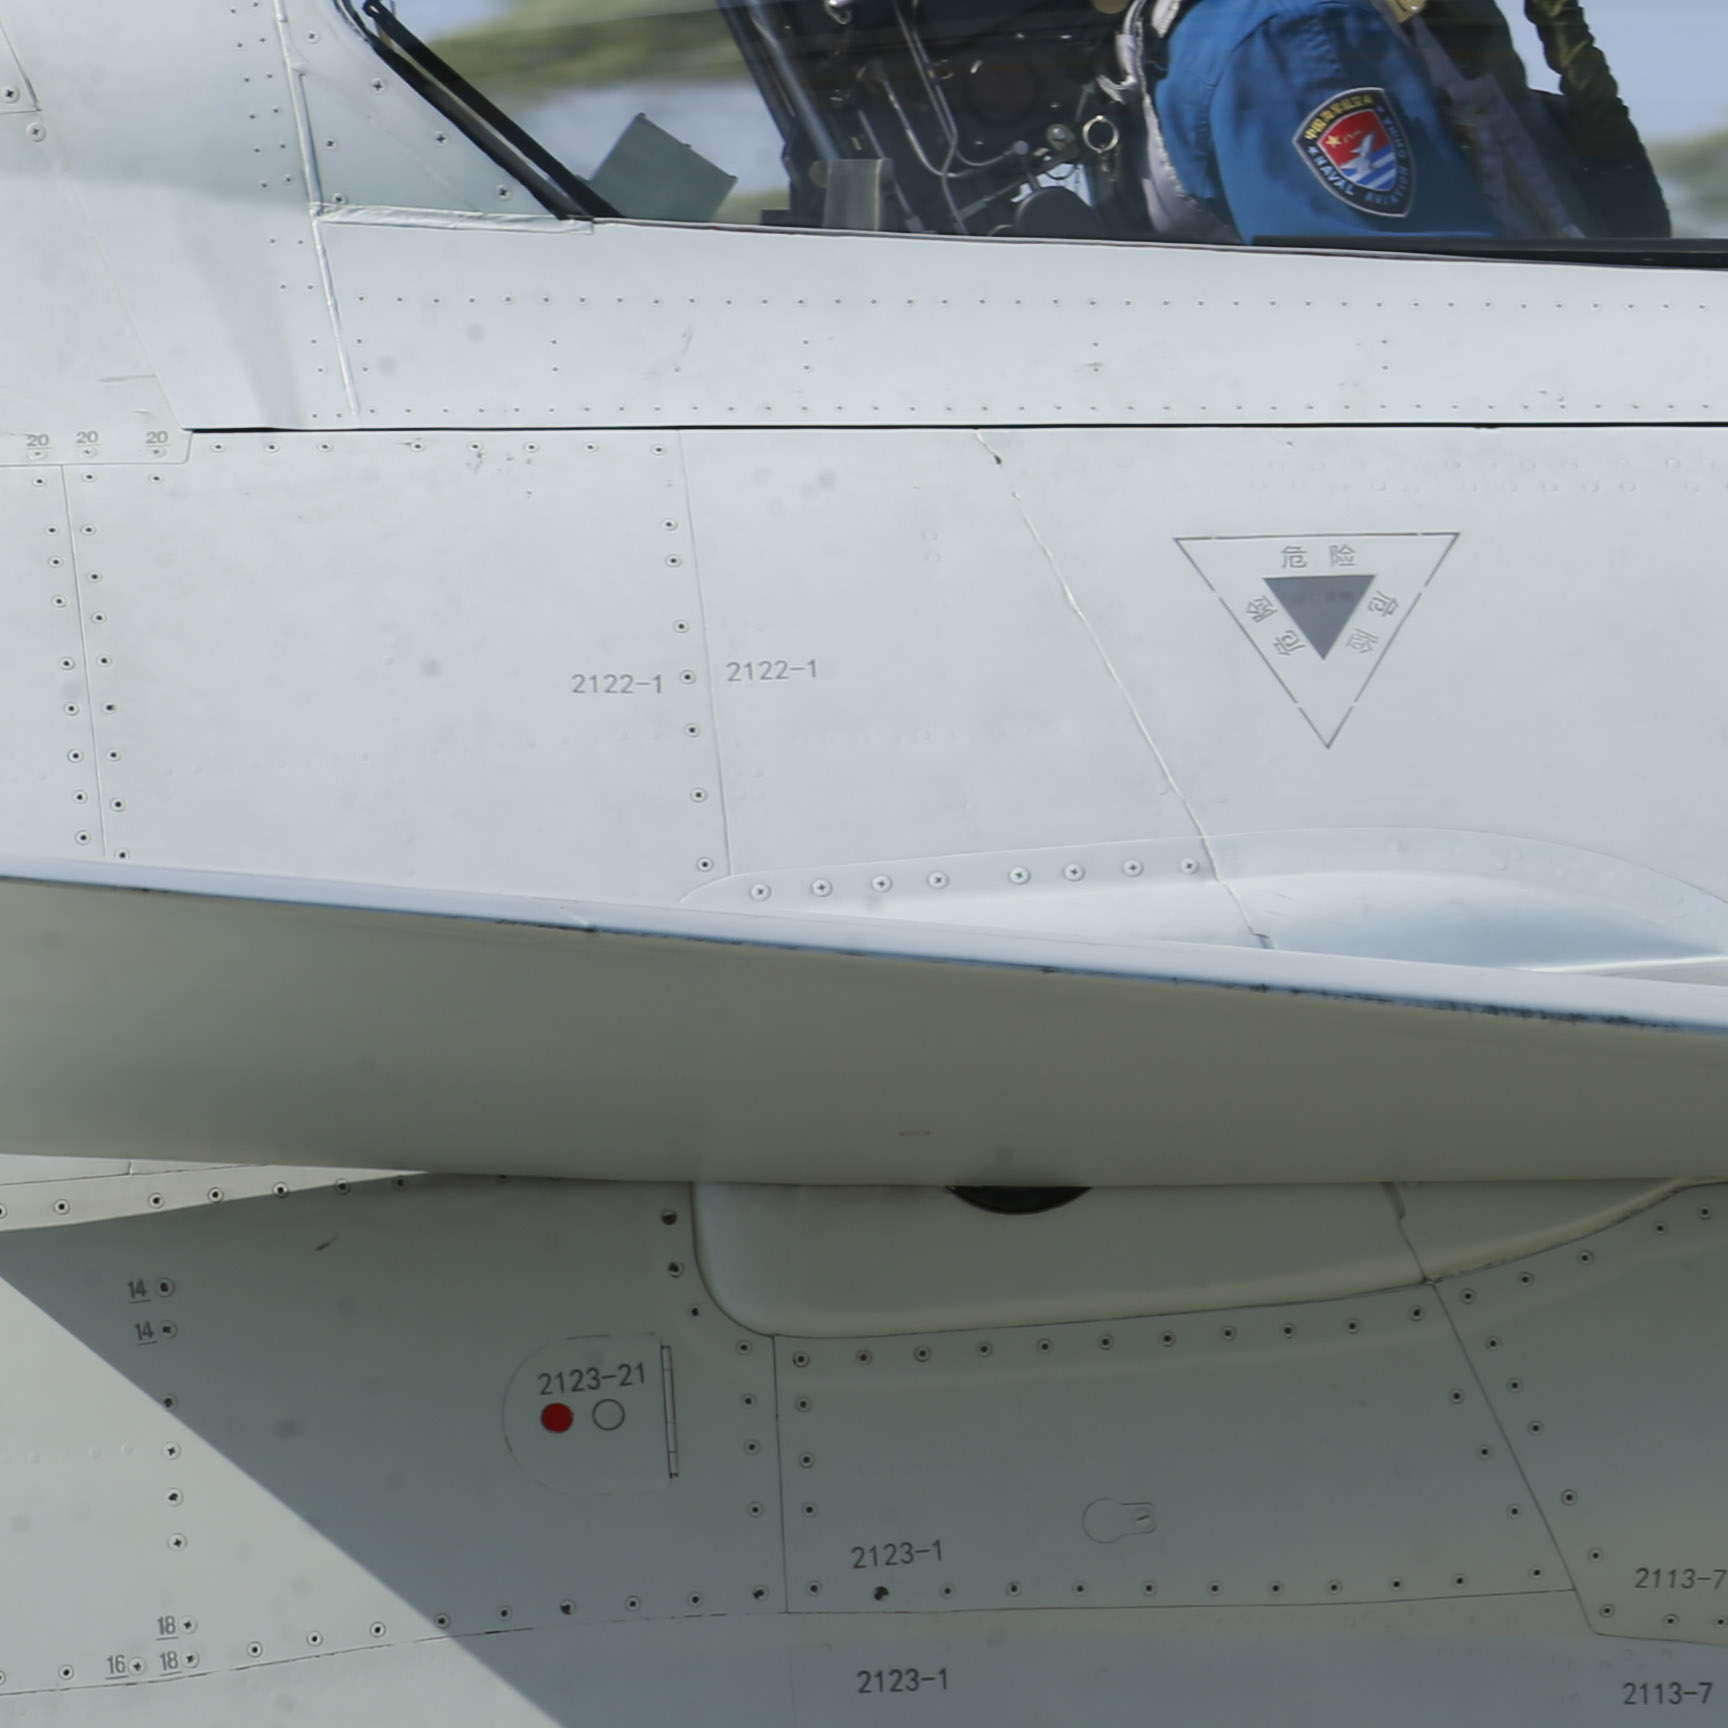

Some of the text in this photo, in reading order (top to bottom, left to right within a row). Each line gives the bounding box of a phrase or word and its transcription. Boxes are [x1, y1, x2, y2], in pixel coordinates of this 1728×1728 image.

[1314, 155, 1355, 196] NAVAL
[26, 433, 50, 448] 20
[75, 430, 99, 445] 20
[145, 430, 169, 445] 20
[1280, 543, 1356, 569] 危险
[1245, 594, 1307, 656] 危险
[1344, 589, 1400, 654] 危险
[725, 659, 817, 682] 2122-1
[571, 674, 663, 694] 2122-1
[127, 1278, 148, 1299] 14
[134, 1320, 155, 1340] 14
[537, 1361, 646, 1395] 2123-21
[851, 1539, 942, 1569] 2123-1
[1634, 1567, 1728, 1589] 2113-7
[157, 1615, 177, 1636] 18
[106, 1654, 127, 1675] 16
[160, 1650, 179, 1671] 18
[856, 1667, 948, 1694] 2123-1
[1622, 1681, 1714, 1705] 2113-7
